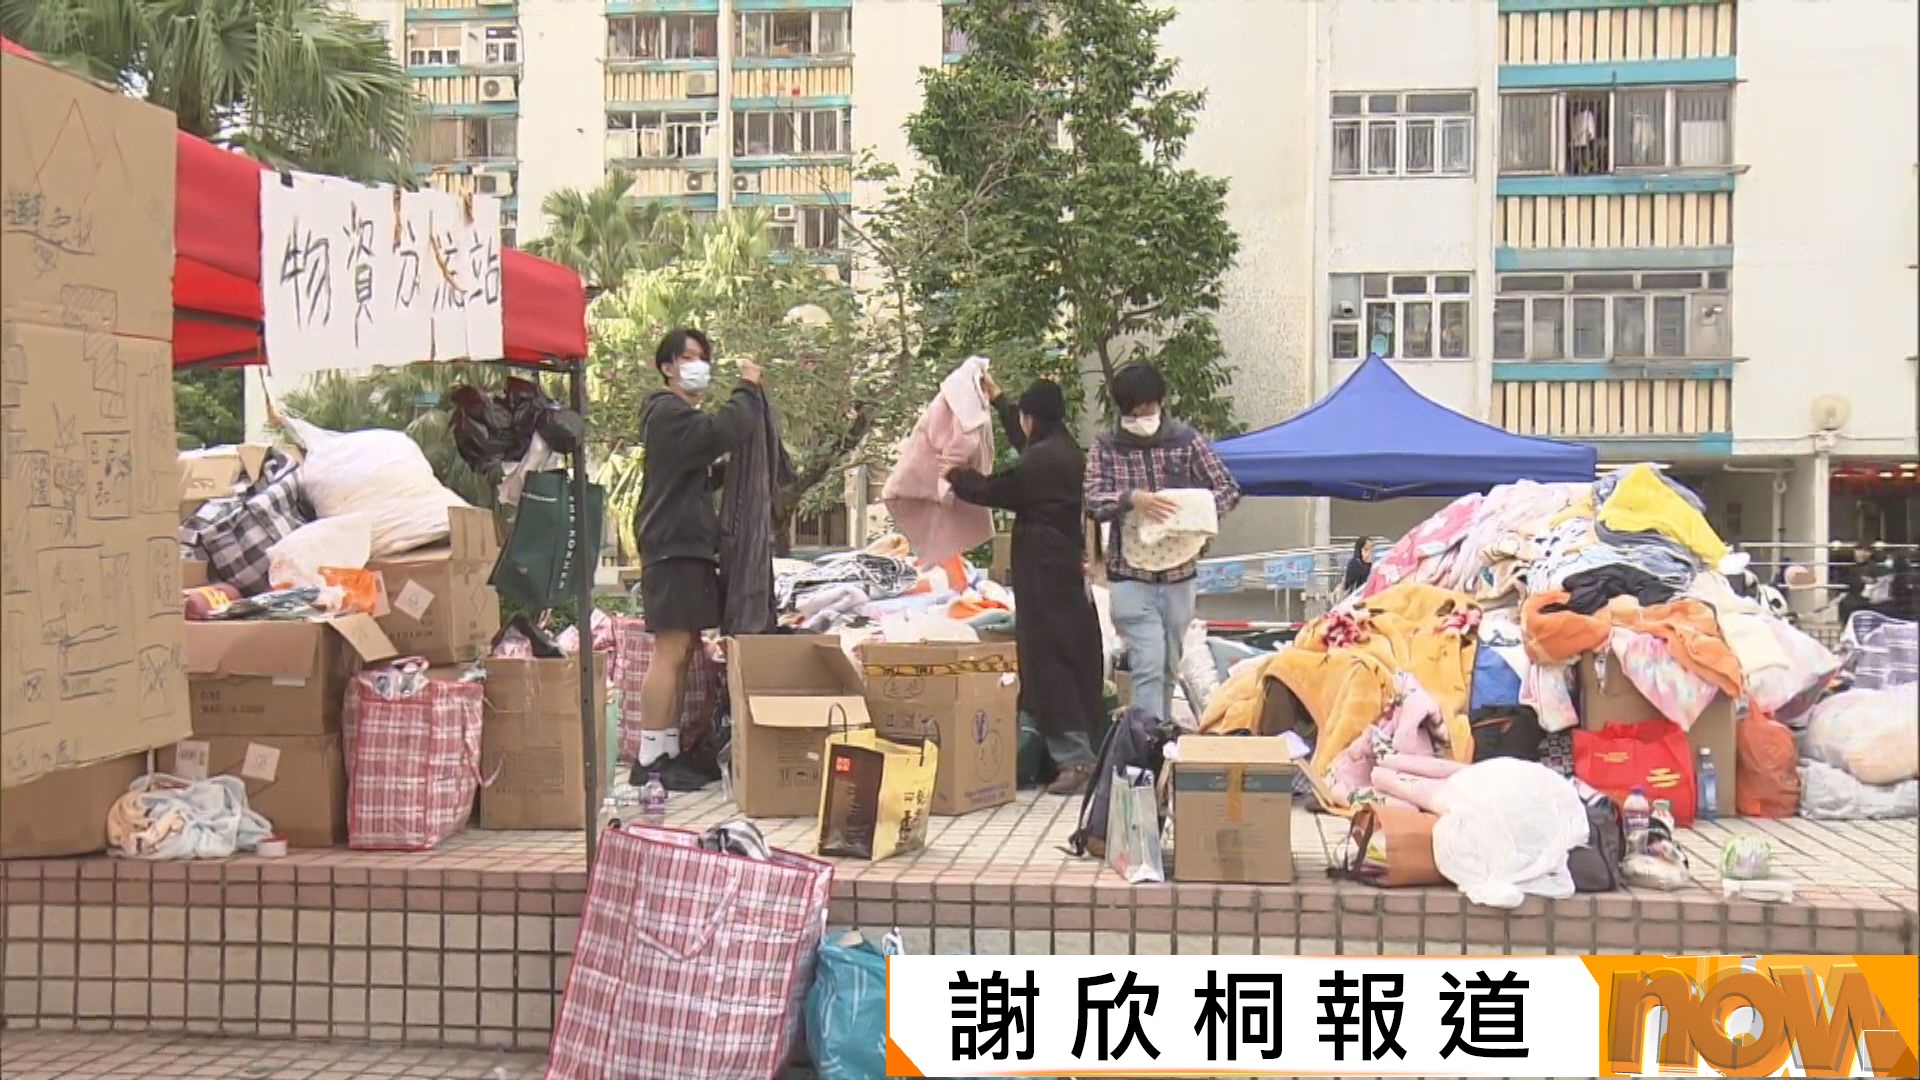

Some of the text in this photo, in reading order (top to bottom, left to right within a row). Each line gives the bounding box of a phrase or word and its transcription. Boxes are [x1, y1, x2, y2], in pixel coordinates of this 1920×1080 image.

[280, 201, 499, 345] 物資分流站
